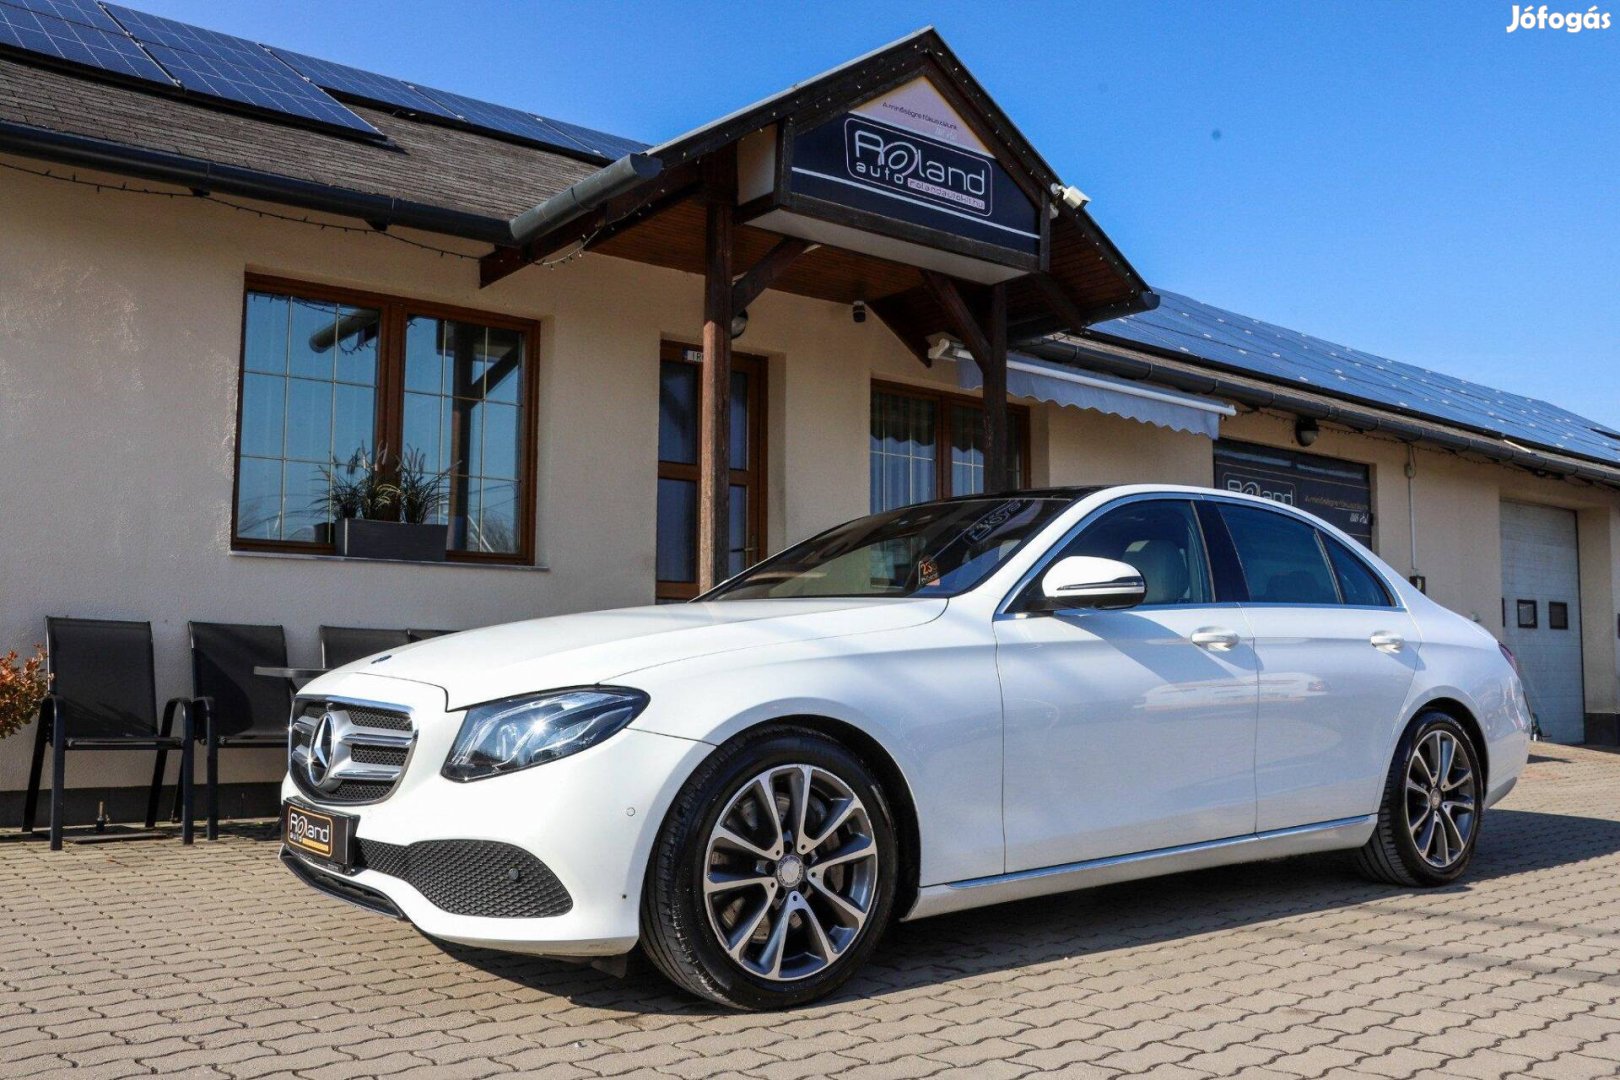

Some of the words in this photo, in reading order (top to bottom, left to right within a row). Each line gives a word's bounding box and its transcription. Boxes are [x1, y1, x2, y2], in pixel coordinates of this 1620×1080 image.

[855, 130, 985, 195] Roland
[856, 161, 904, 185] auto
[290, 812, 330, 843] Roland
